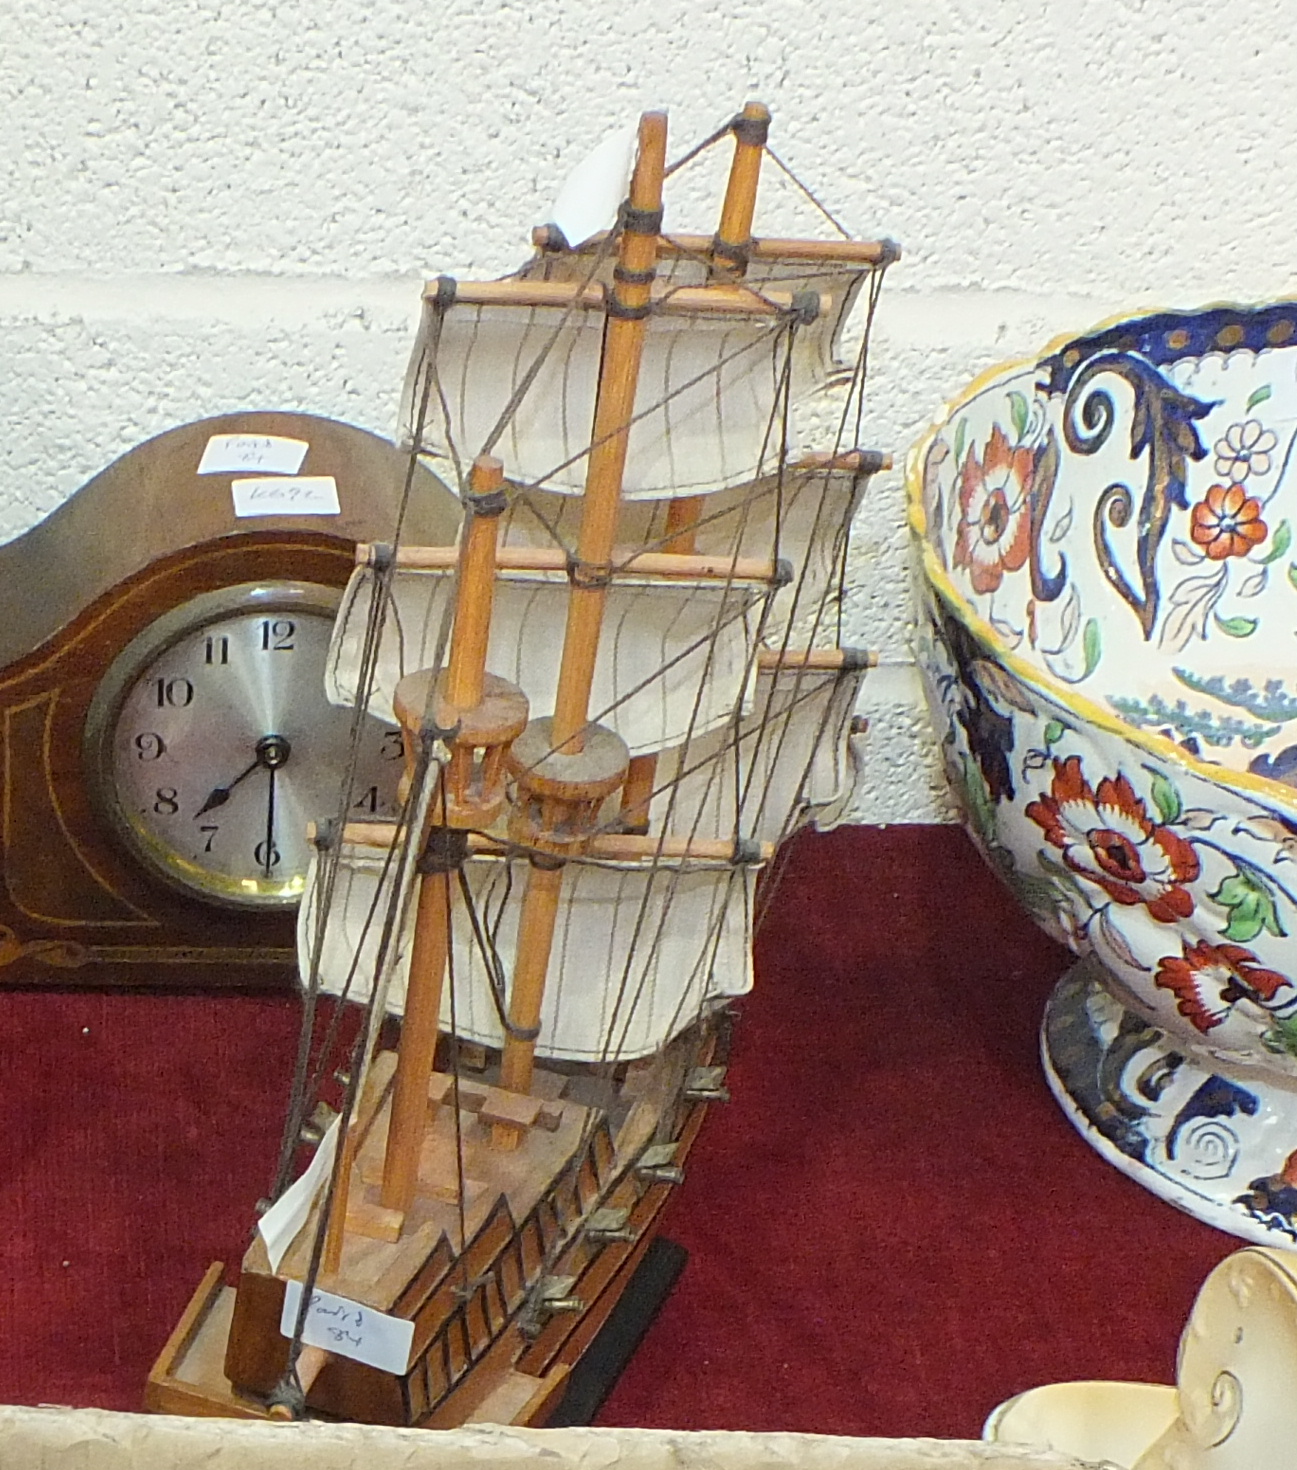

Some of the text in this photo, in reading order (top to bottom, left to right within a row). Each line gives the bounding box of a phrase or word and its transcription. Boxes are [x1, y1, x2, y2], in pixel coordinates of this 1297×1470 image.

[260, 620, 295, 651] 12
[204, 636, 229, 665] 11
[155, 677, 194, 708] 10
[135, 732, 166, 761] 9
[154, 787, 179, 815] 8
[353, 786, 385, 812] 4
[200, 826, 219, 852] 7
[254, 840, 280, 867] 6
